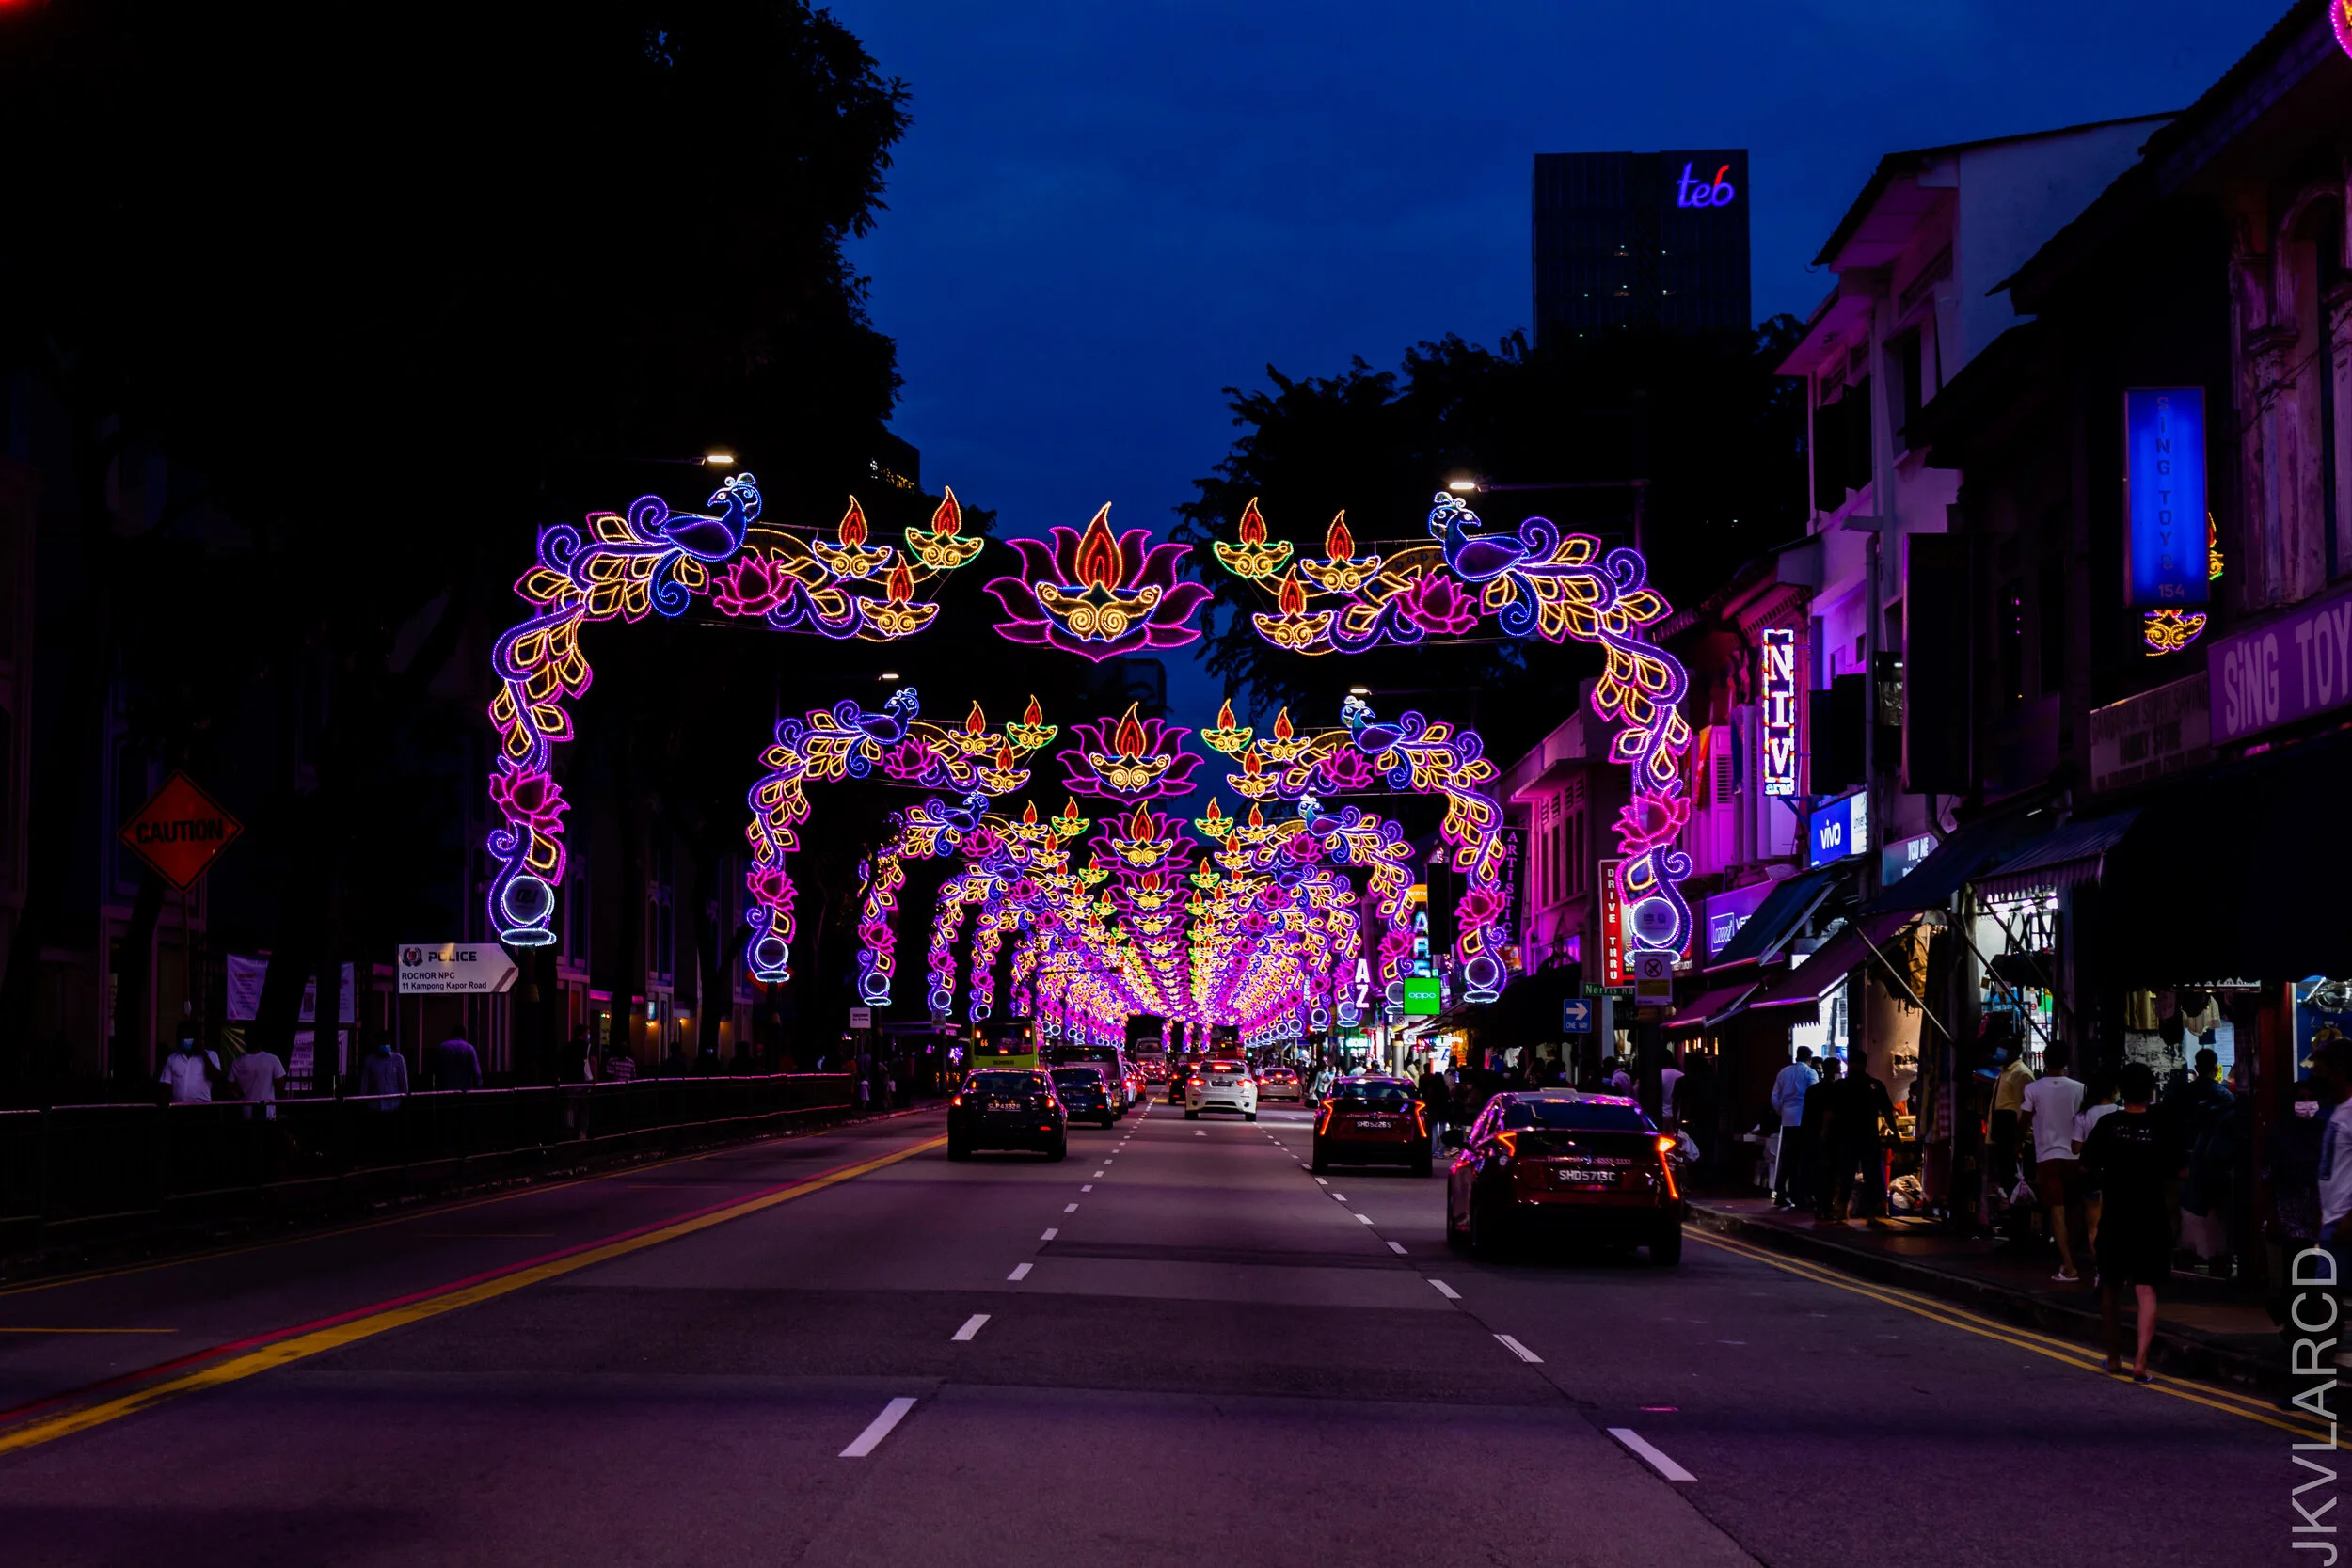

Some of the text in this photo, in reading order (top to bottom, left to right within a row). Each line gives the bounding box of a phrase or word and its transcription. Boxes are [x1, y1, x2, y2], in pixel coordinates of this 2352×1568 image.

[2157, 583, 2185, 599] 154
[1768, 643, 1794, 775] NIV
[136, 818, 224, 843] CAUTION
[1820, 819, 1841, 850] vivo
[1907, 839, 1919, 862] YOU
[1607, 868, 1618, 980] DRIVE THRU
[428, 951, 477, 962] POLICE
[411, 982, 444, 990] Kampong
[446, 981, 467, 990] Kapor
[469, 981, 486, 990] Road
[1355, 958, 1370, 1008] AZ
[1585, 985, 1617, 995] Norris
[1408, 992, 1437, 1001] oppo
[980, 1038, 989, 1047] 66
[1558, 1169, 1616, 1182] SHD5713C
